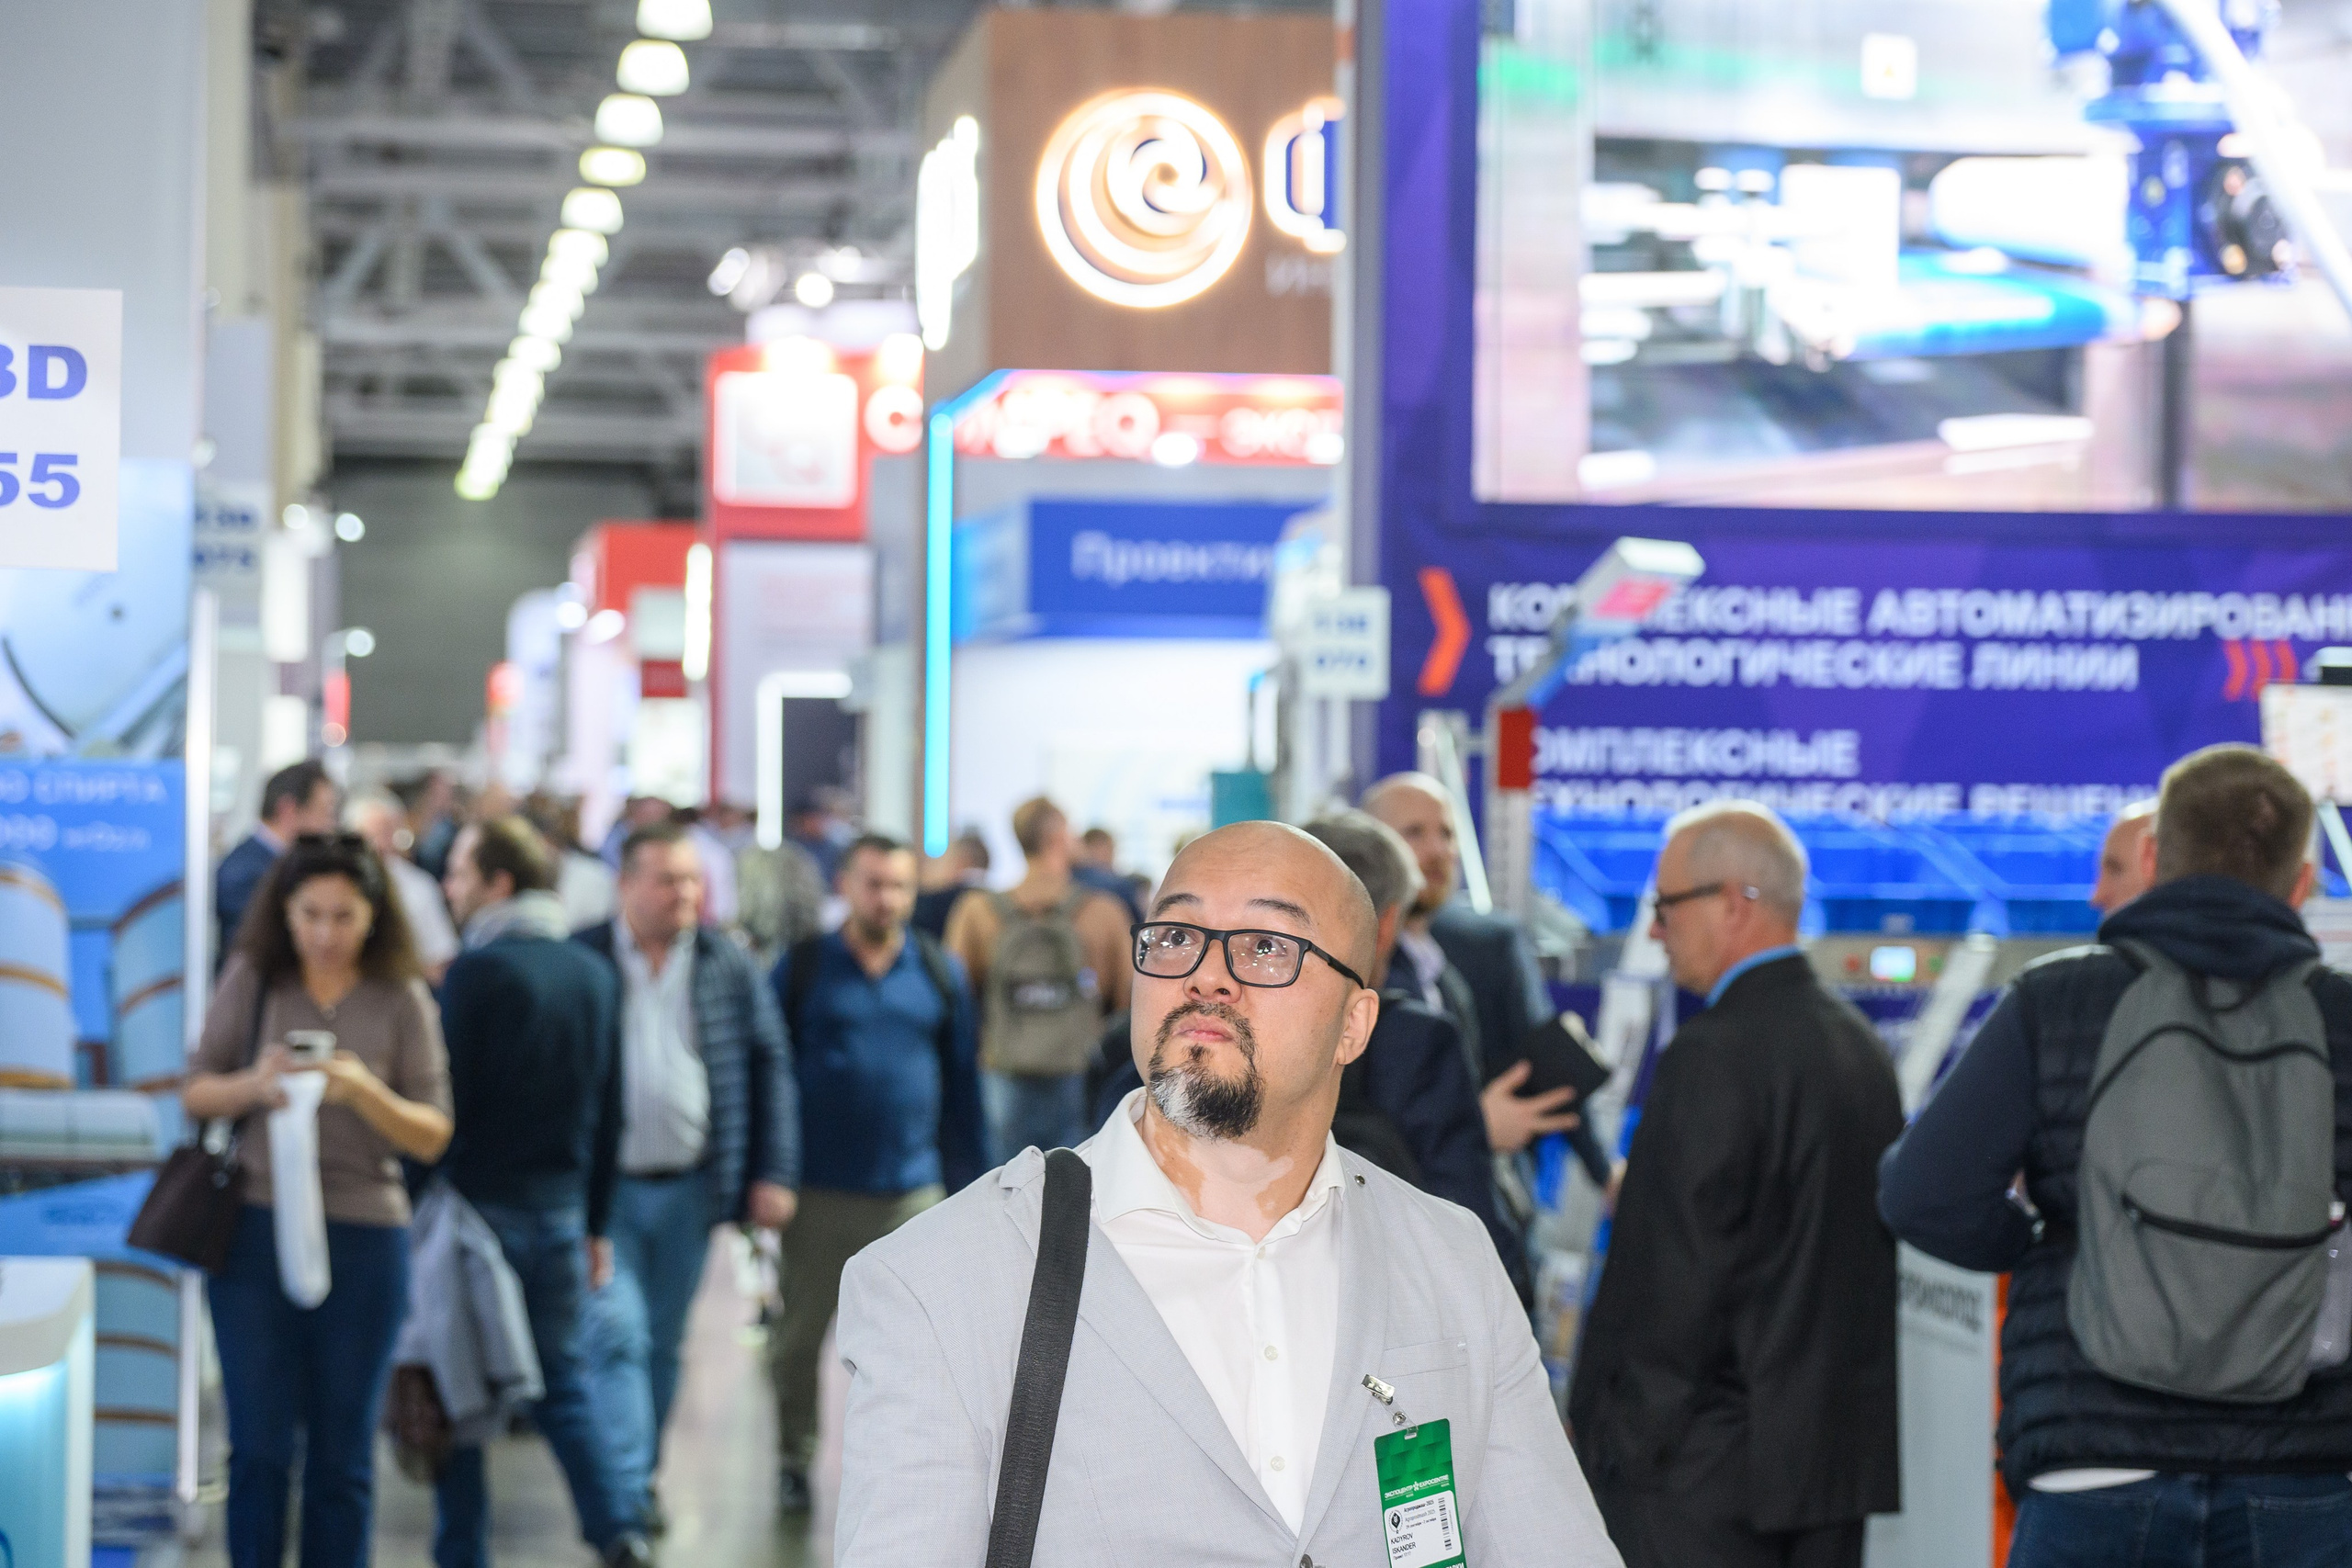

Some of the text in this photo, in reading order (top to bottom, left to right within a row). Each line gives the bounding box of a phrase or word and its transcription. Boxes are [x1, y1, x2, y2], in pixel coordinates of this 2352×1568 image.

[1969, 642, 2140, 693] ЛИНИИ
[1532, 726, 1860, 778] ОМПЛЕКСНЫЕ
[1391, 1533, 1413, 1545] KADYROV
[1393, 1542, 1416, 1554] ISKANDER
